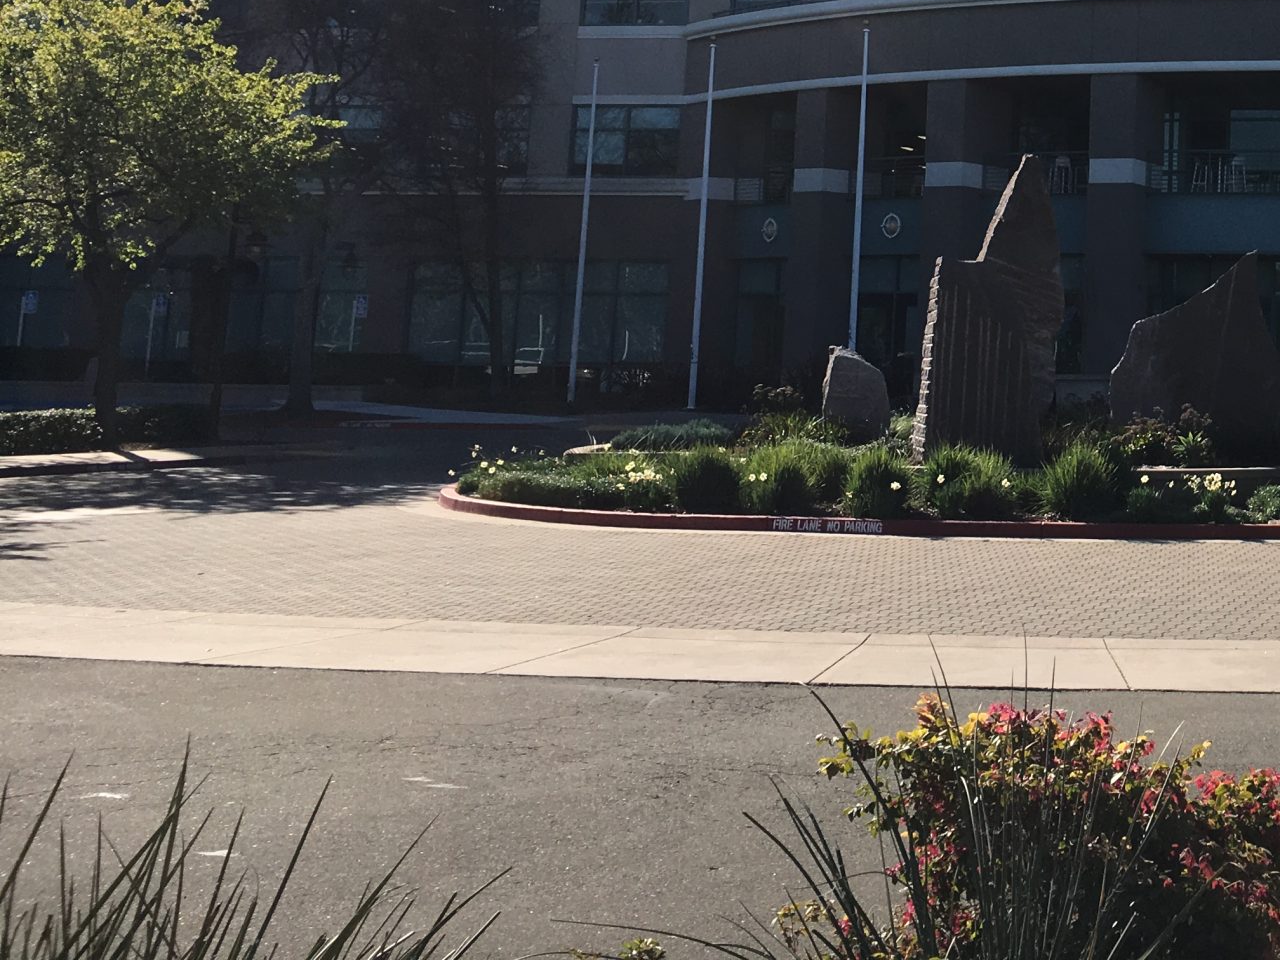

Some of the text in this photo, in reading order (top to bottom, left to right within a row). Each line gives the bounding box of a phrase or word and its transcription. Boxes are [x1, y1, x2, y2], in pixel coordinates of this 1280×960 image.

[773, 518, 883, 533] FIRE LANE NO PARKING
